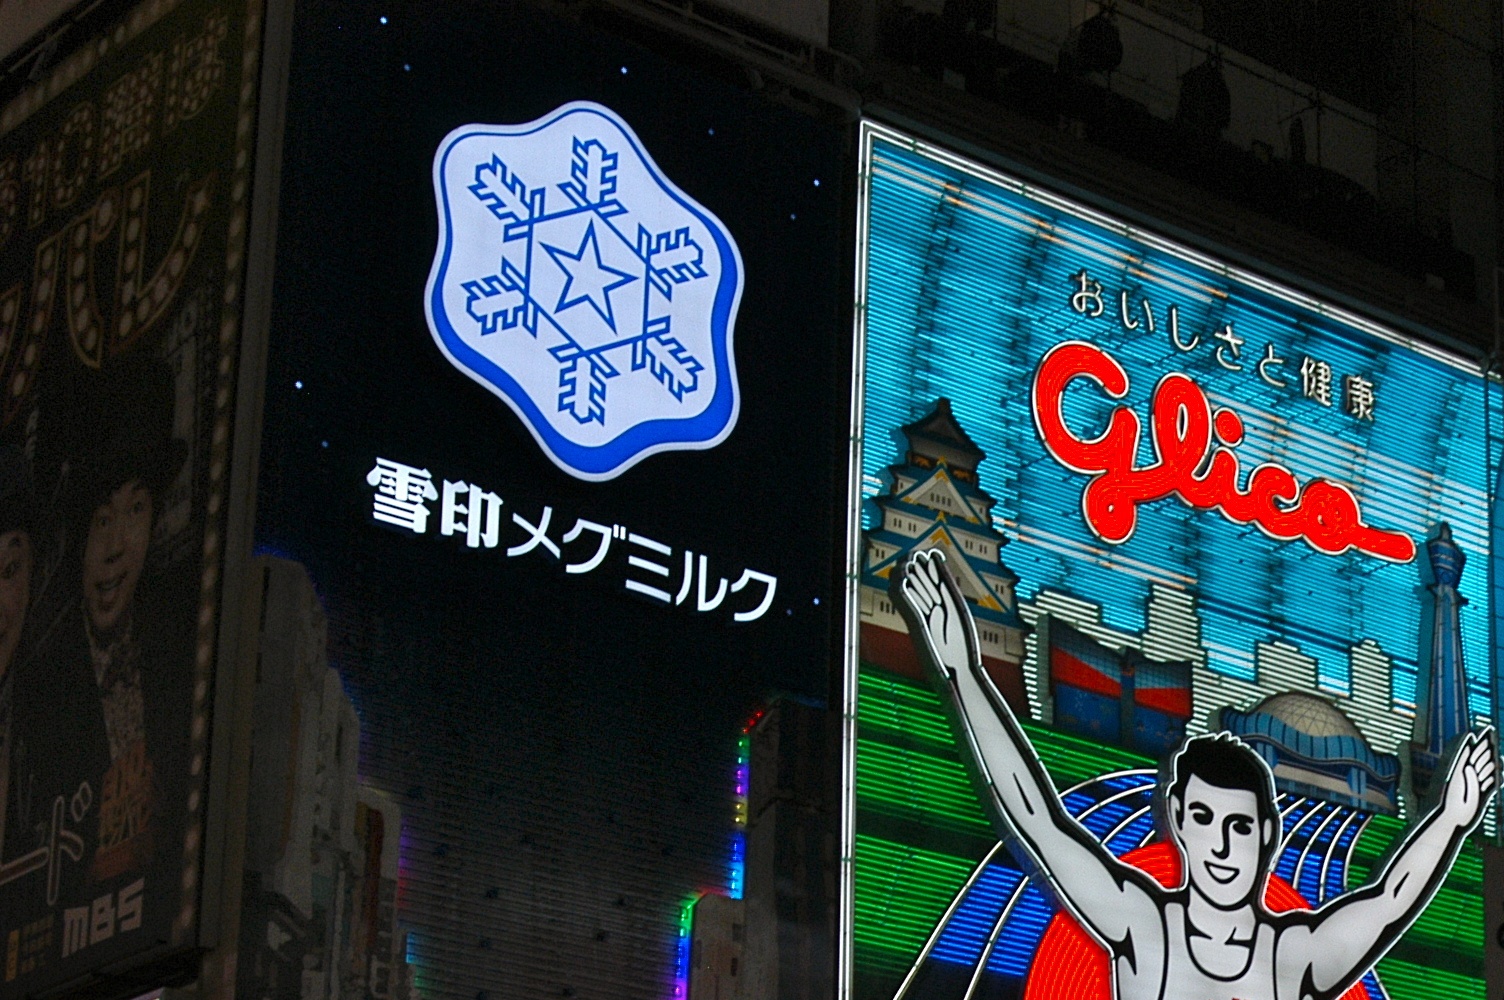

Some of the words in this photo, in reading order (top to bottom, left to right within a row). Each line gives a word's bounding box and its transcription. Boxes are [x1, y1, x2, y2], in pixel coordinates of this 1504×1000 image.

[1070, 272, 1375, 421] おいしさと健康
[1031, 341, 1418, 564] Glico
[366, 457, 779, 623] 雪印メグミルク
[61, 877, 146, 959] MBS
